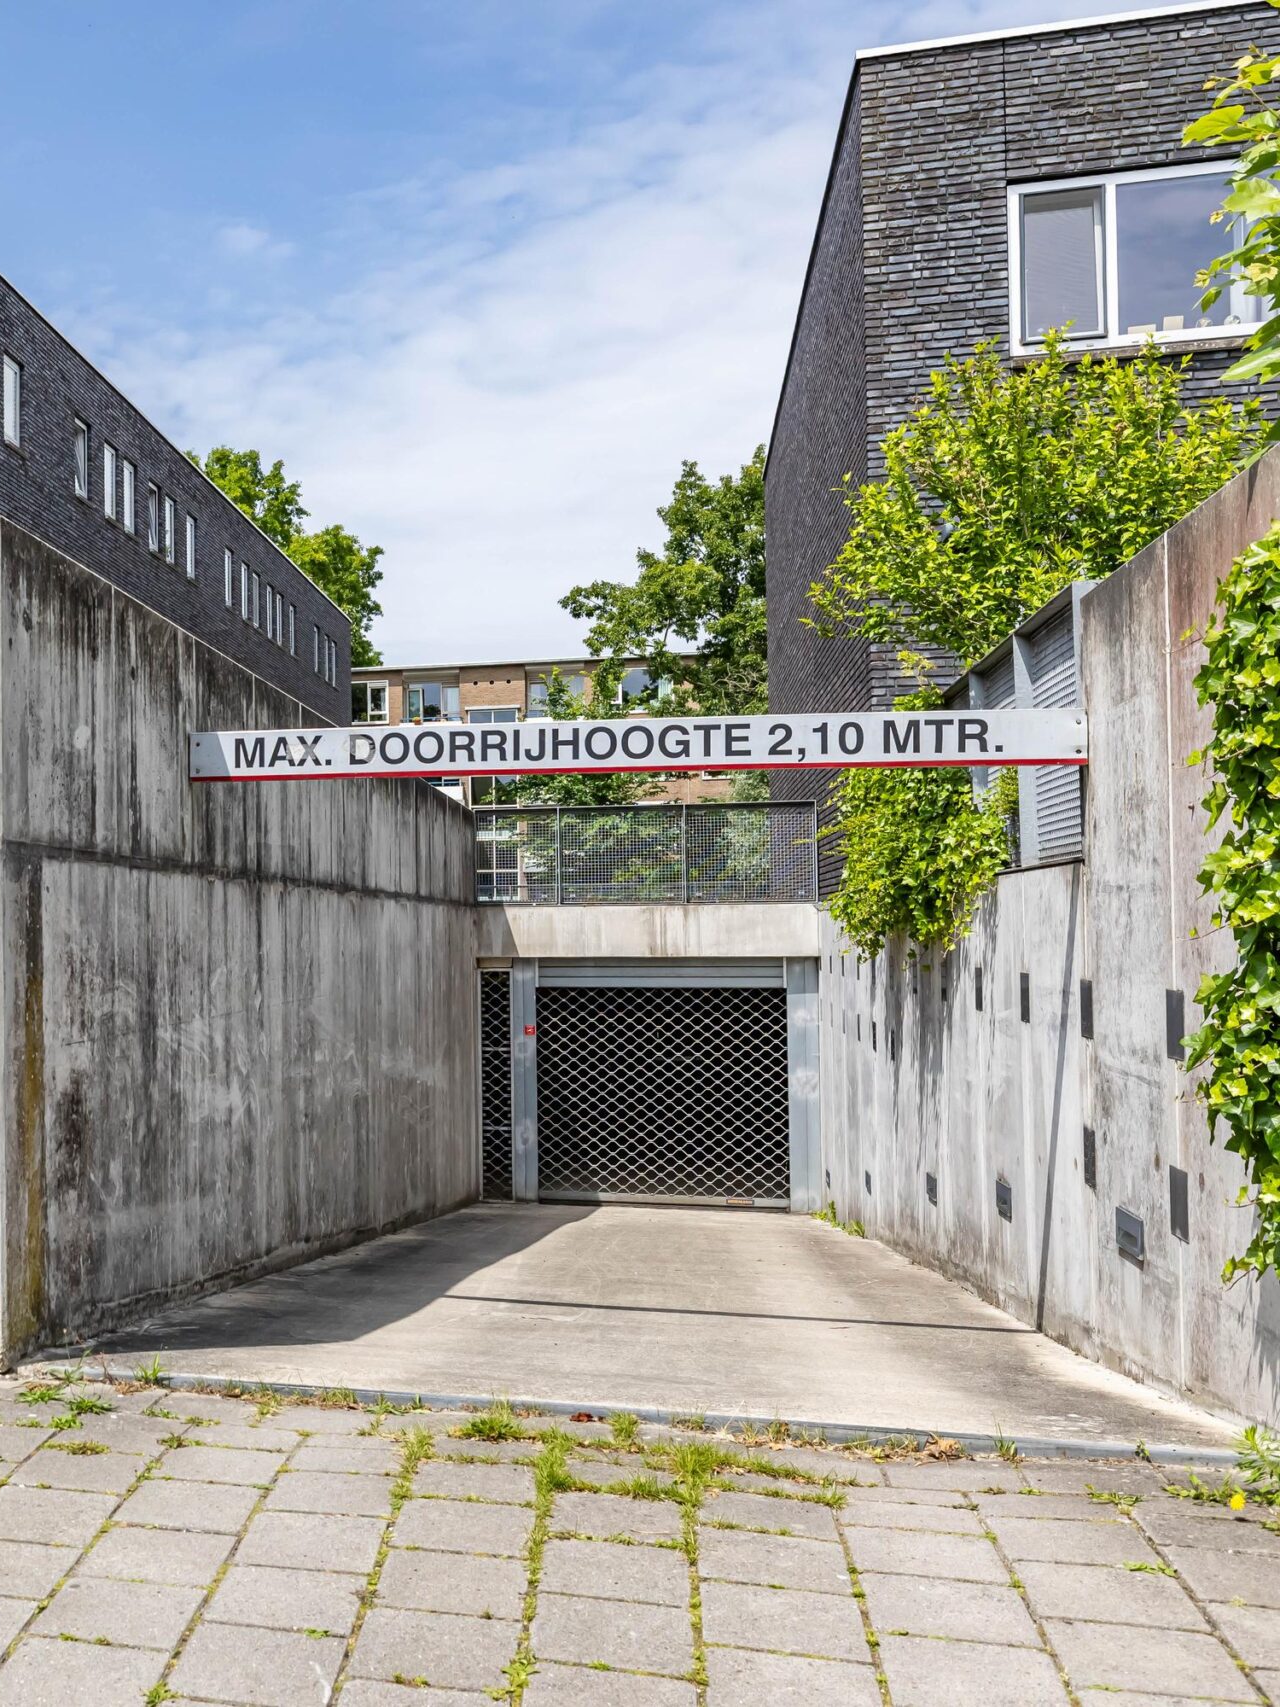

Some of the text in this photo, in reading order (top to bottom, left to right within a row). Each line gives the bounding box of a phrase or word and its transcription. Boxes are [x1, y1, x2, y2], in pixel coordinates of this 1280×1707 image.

[234, 718, 1004, 769] MAX. DOORRIJHOOGTE 2,10 MTR.
